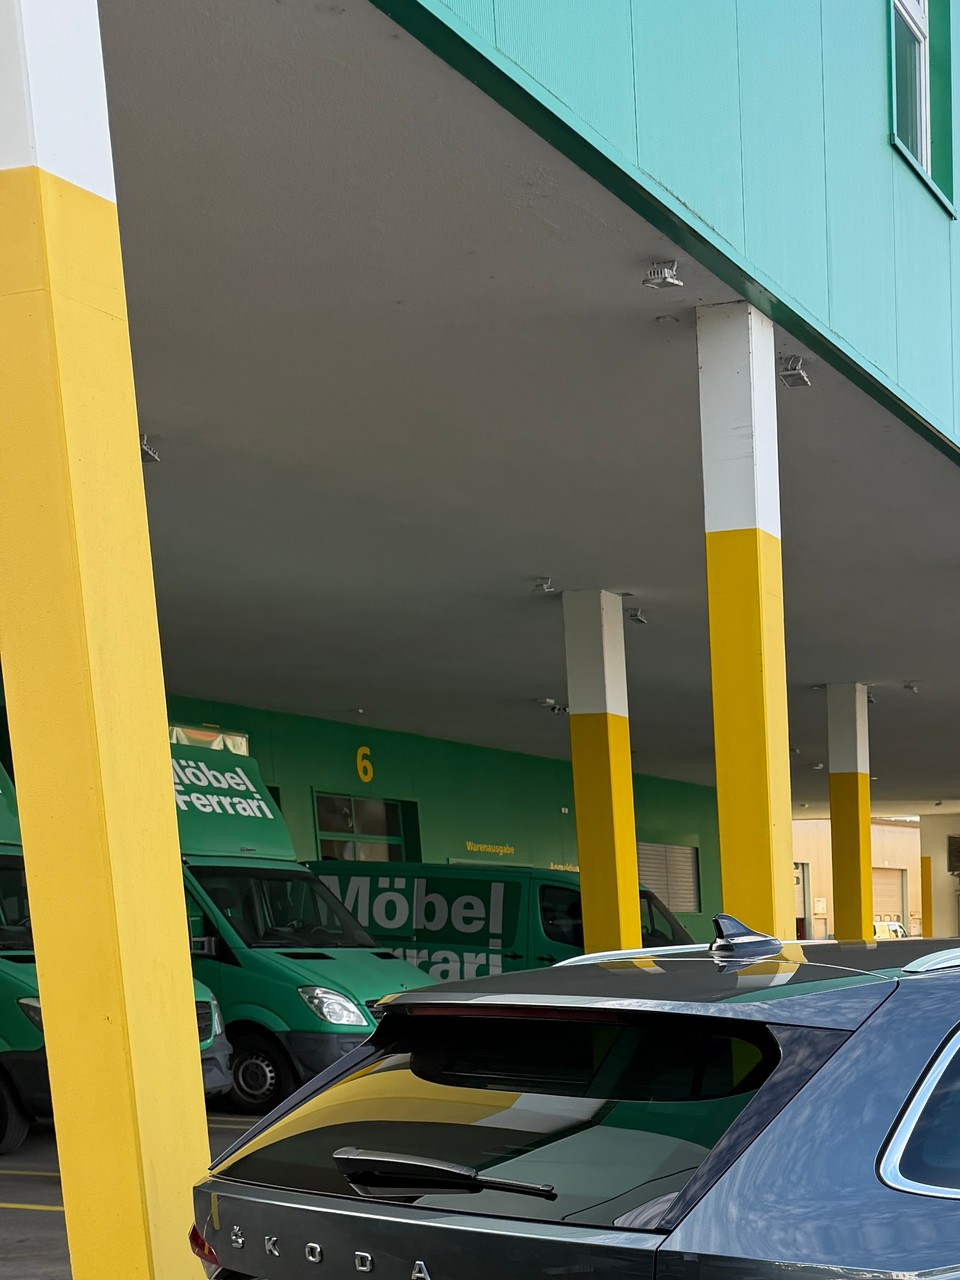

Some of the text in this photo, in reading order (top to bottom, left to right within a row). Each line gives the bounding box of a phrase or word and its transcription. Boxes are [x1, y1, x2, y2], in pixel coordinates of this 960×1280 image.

[356, 746, 374, 783] 6
[174, 784, 274, 819] Ferrari
[465, 841, 515, 855] Warenausgabe
